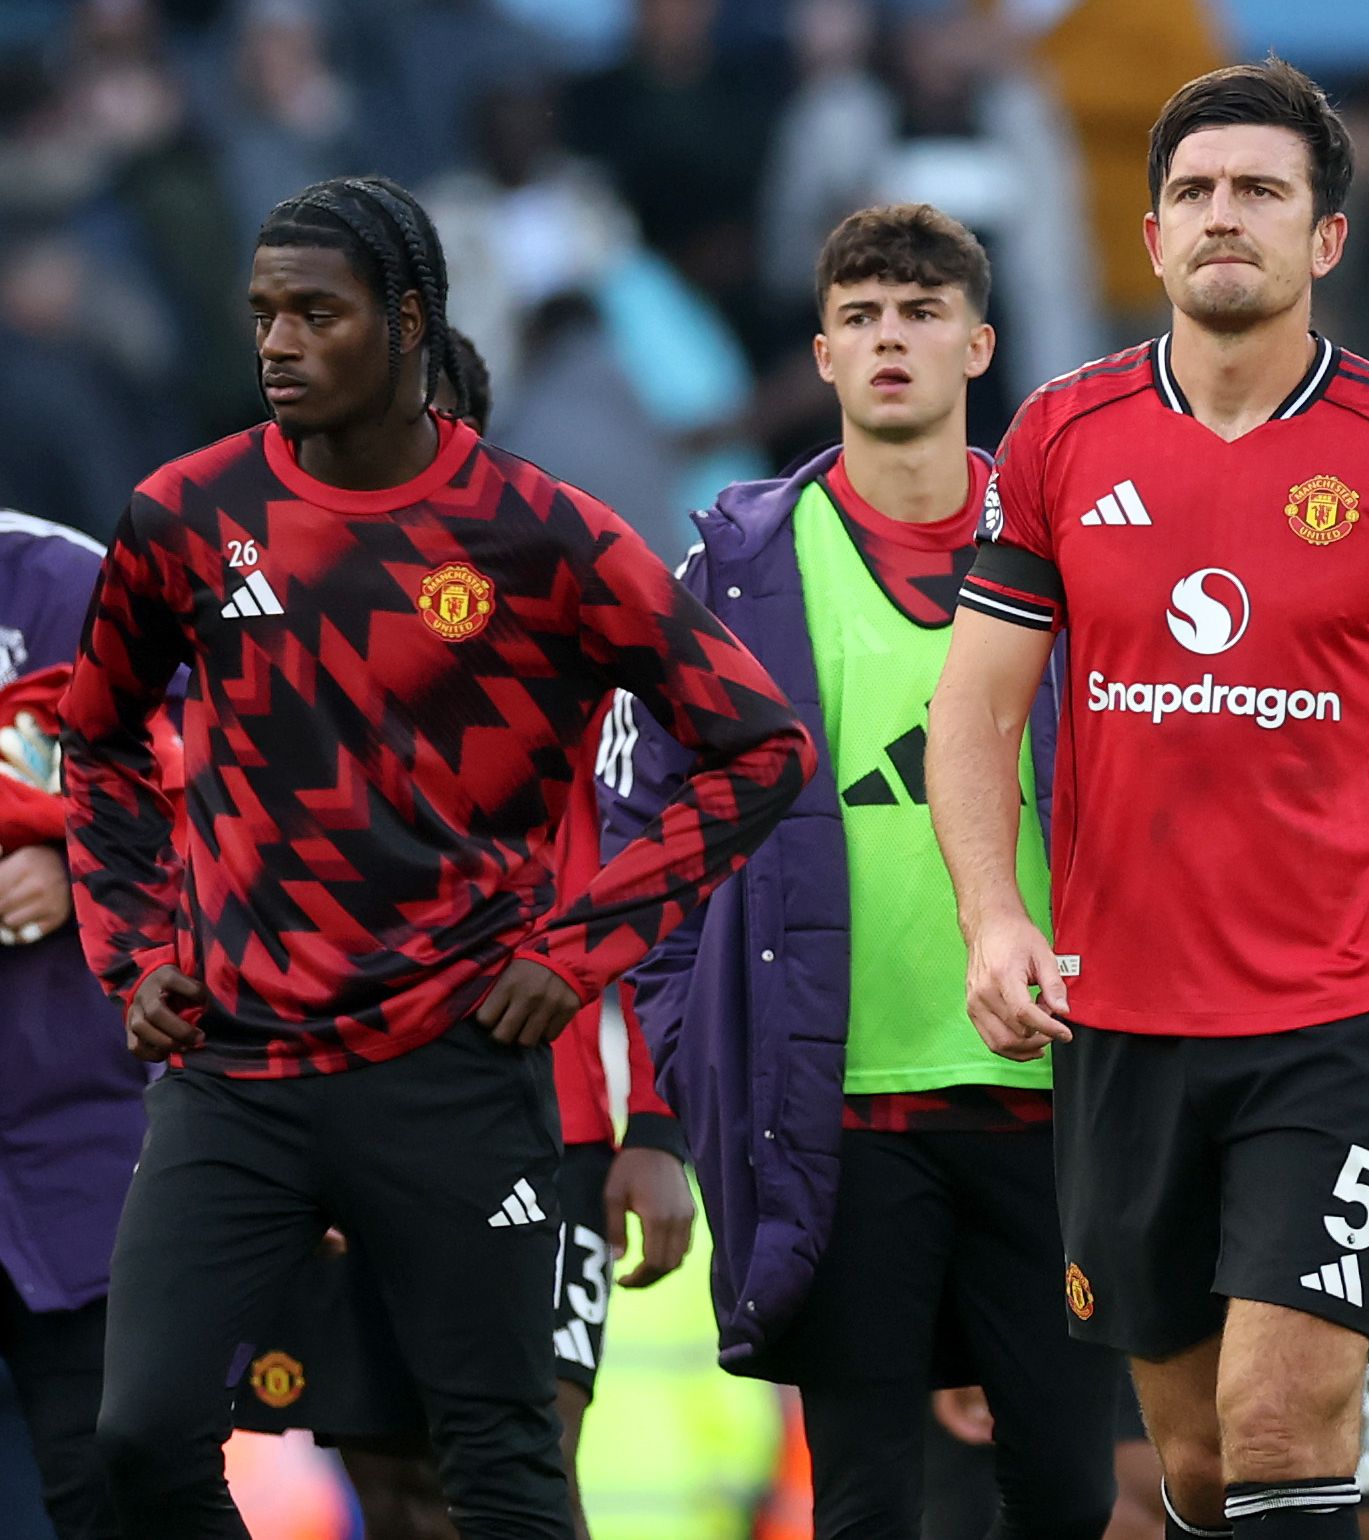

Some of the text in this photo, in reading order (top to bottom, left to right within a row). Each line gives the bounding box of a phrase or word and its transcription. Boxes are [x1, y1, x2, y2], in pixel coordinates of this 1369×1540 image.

[1294, 479, 1355, 505] MANCHESTER
[1299, 526, 1341, 540] UNITED
[227, 539, 259, 567] 26
[432, 618, 473, 633] UNITED
[1088, 670, 1341, 729] Snapdragon
